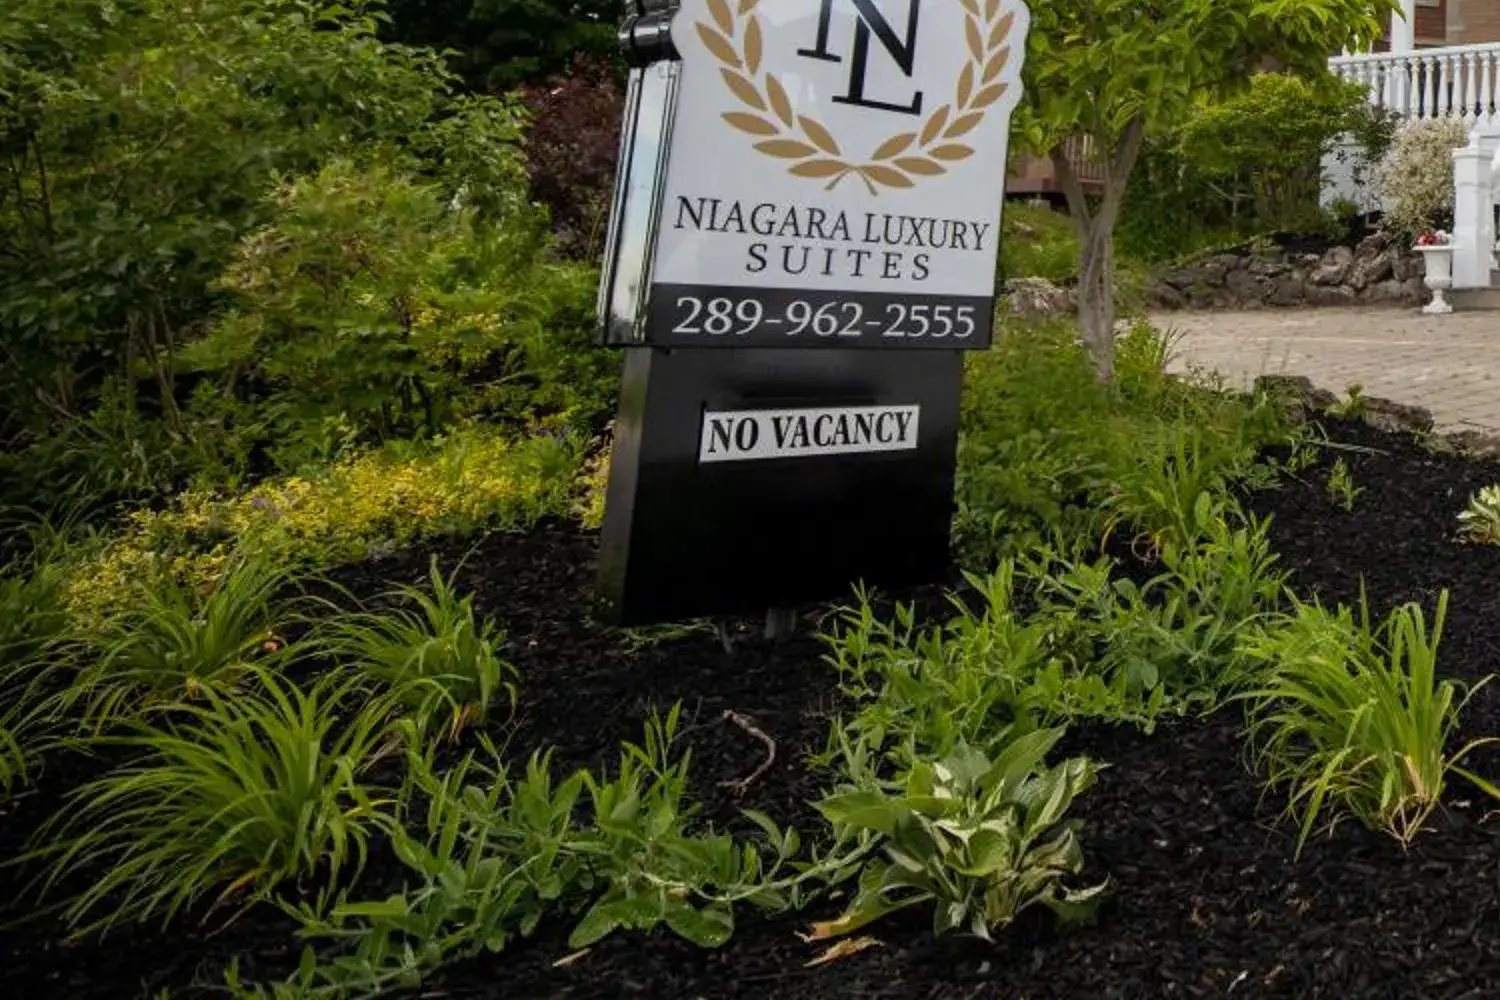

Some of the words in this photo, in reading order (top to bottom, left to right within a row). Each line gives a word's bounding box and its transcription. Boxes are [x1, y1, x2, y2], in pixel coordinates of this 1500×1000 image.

[674, 196, 850, 242] NIAGARA
[864, 213, 990, 251] LUXURY
[746, 243, 930, 280] SUITES
[672, 297, 976, 337] 289-962-2555
[708, 417, 759, 453] NO
[771, 411, 912, 448] VACANCY
